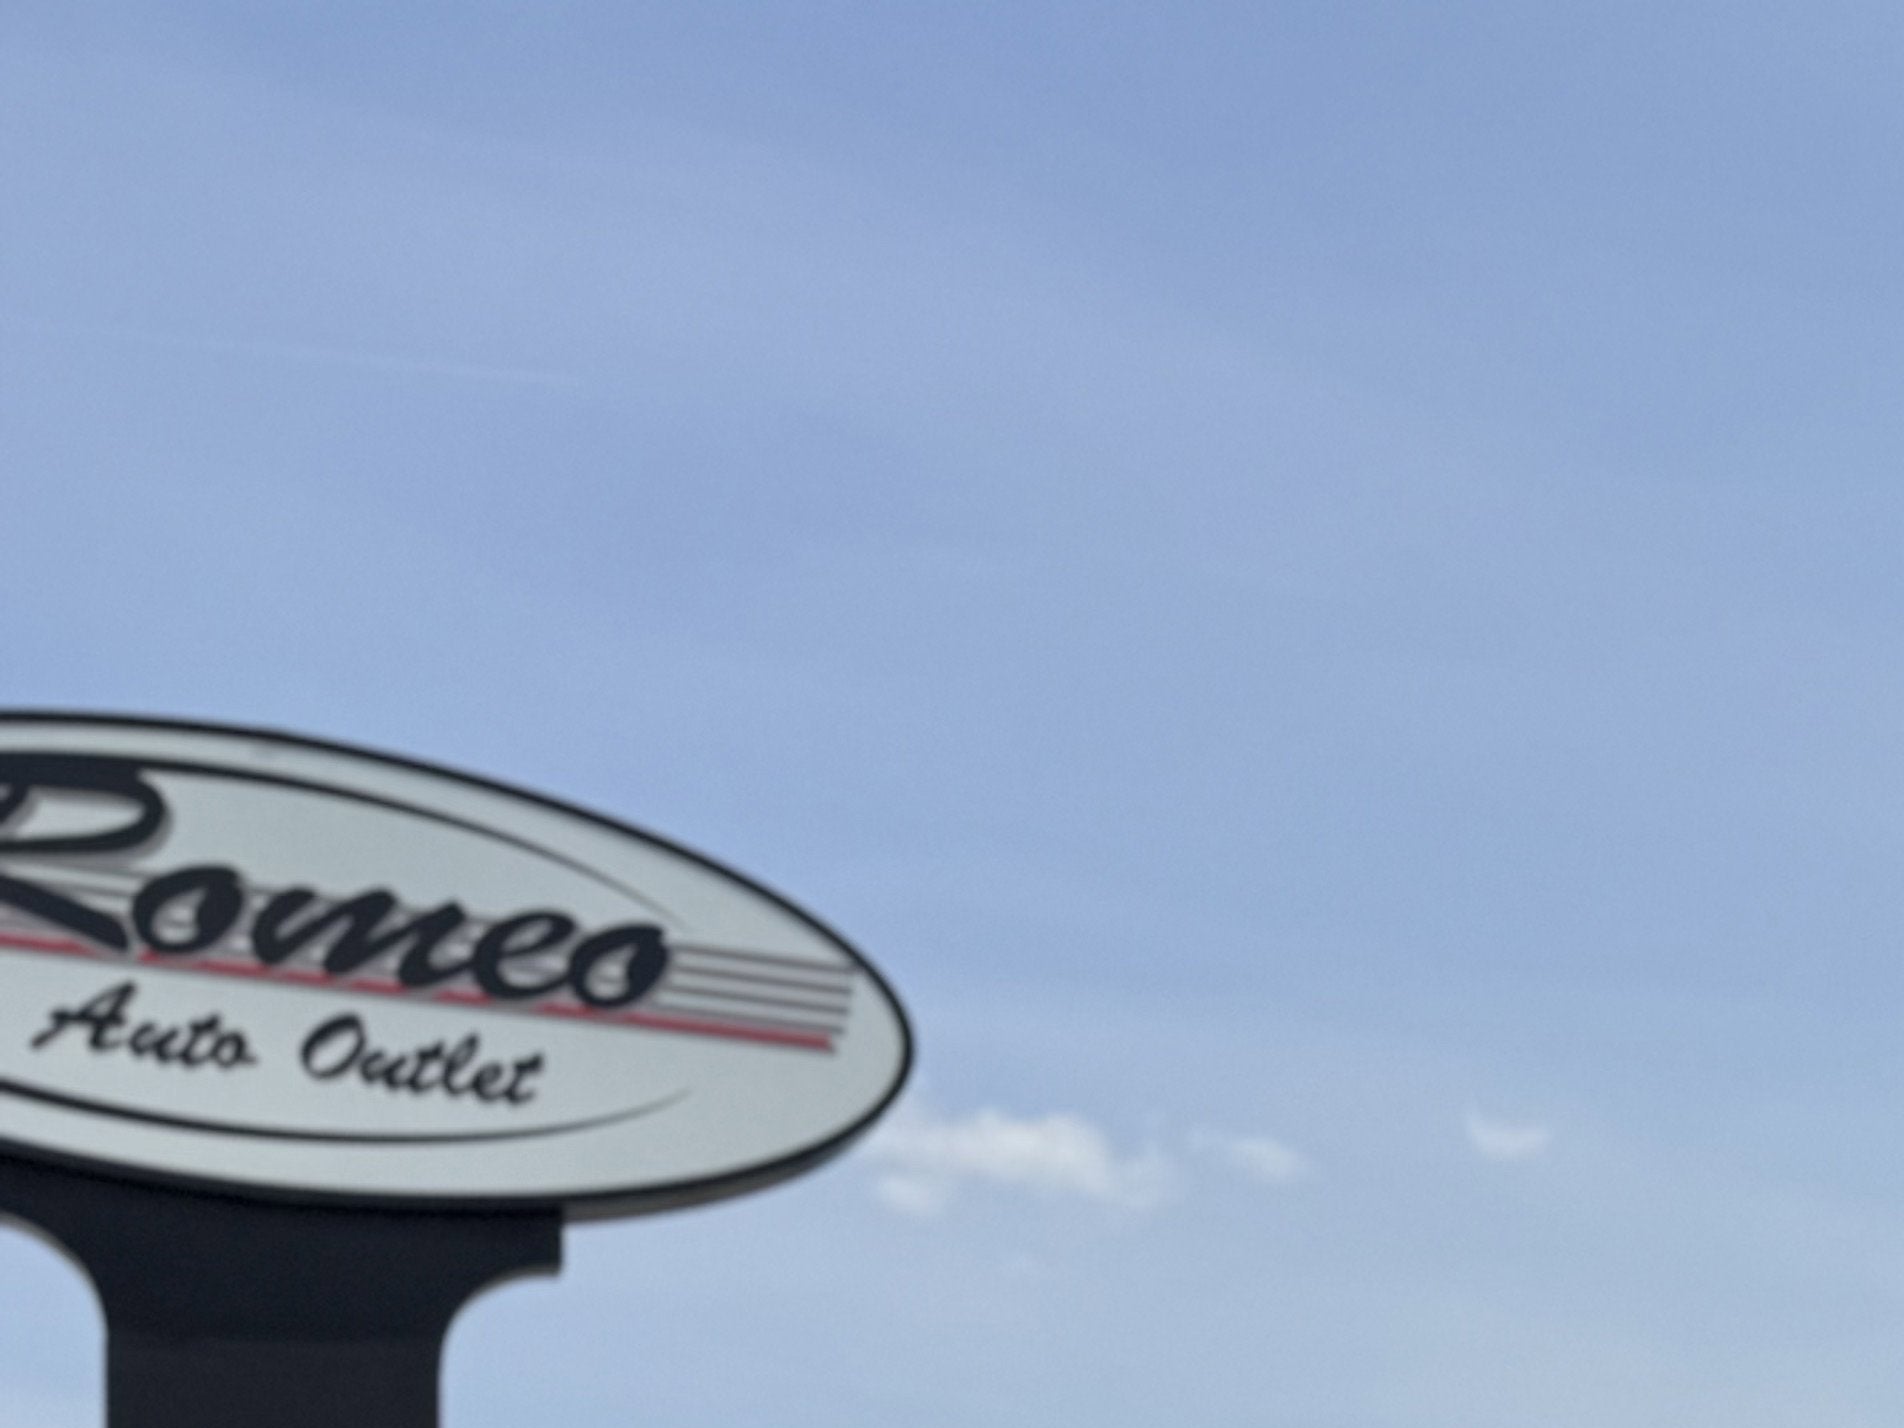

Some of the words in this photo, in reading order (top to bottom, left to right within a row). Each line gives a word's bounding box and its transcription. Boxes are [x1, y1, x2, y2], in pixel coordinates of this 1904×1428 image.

[0, 753, 673, 1010] Romeo
[30, 981, 259, 1069] Auto
[300, 1013, 547, 1107] Outlet
